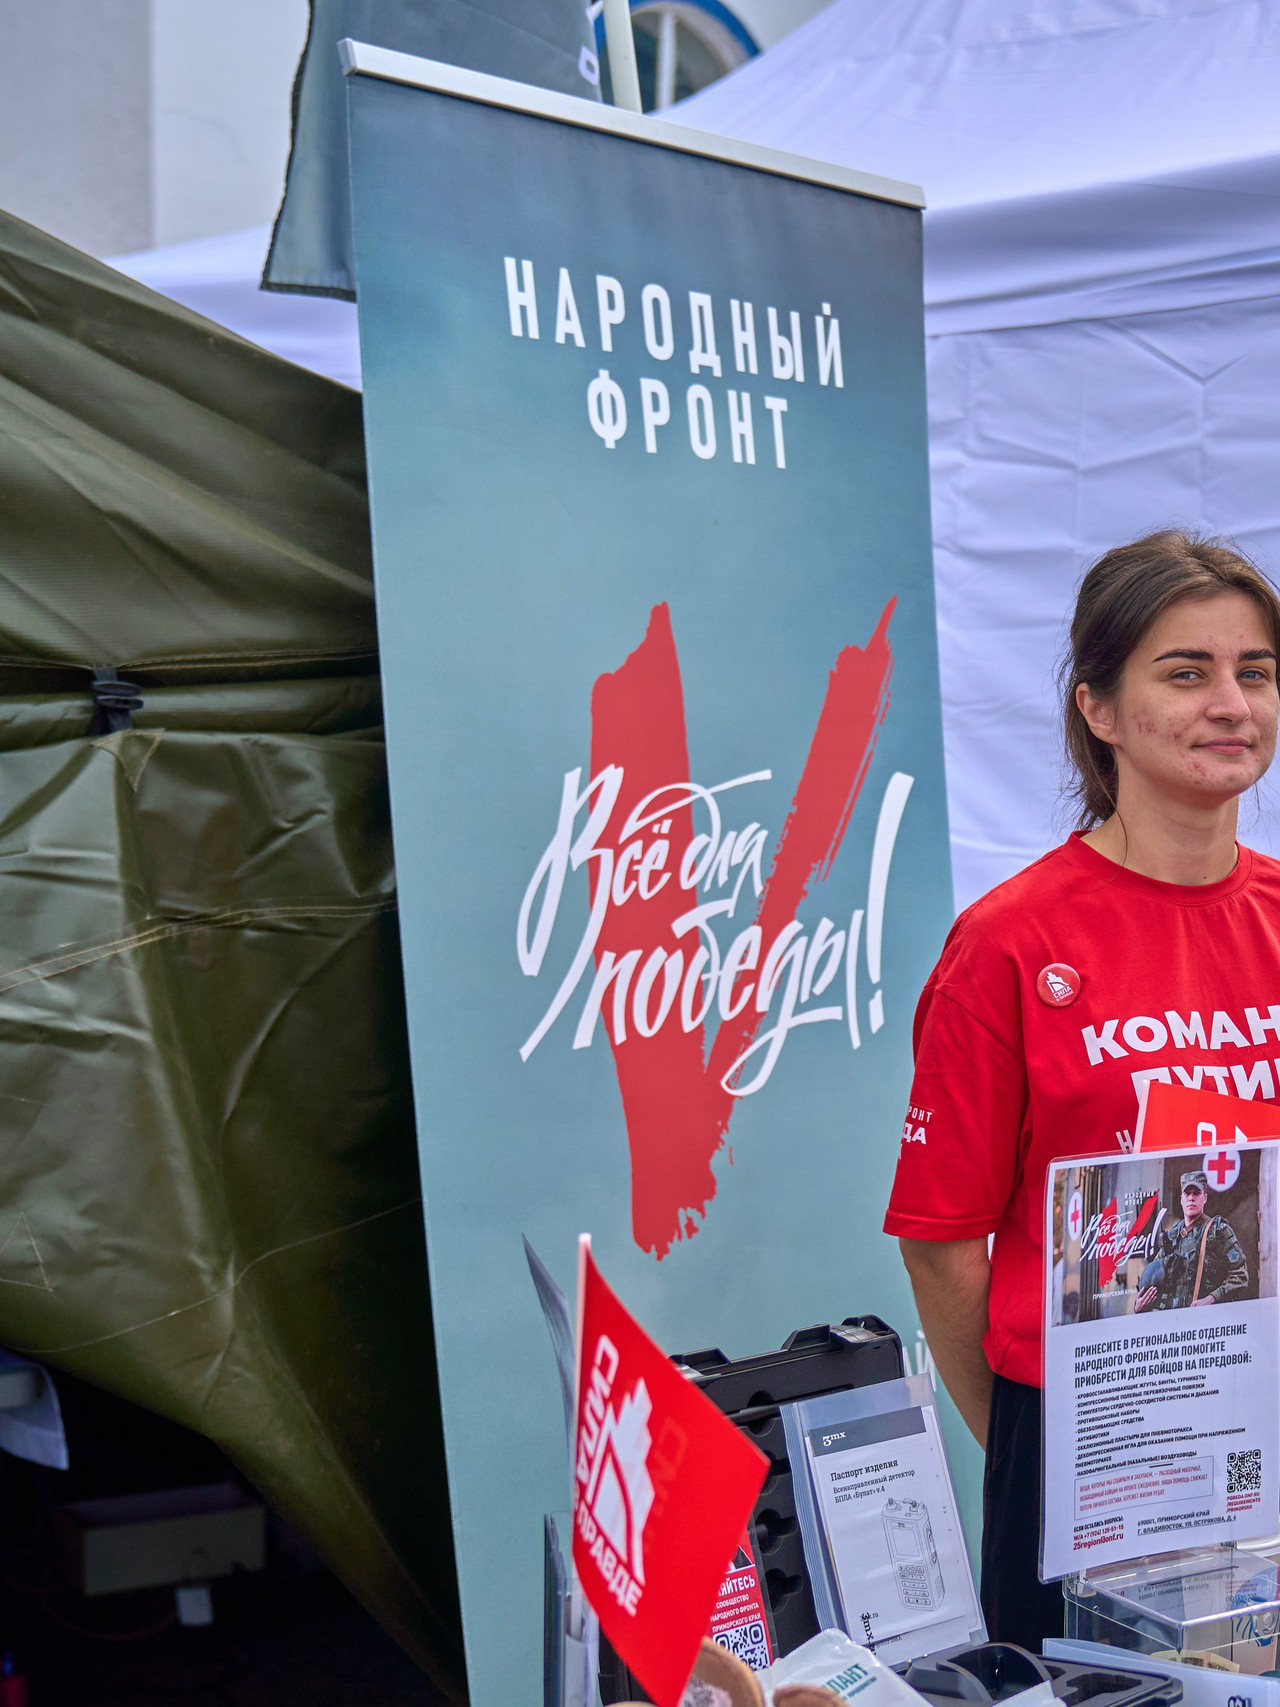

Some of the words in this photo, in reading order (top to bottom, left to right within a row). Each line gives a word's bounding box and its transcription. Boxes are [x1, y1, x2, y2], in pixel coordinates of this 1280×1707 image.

[504, 255, 844, 389] НАРОДНЫЙ
[587, 369, 788, 469] ФРОНТ
[516, 764, 672, 1062] Всё
[619, 768, 772, 897] для
[572, 771, 914, 1096] победы!
[907, 1105, 933, 1123] РОНТ
[1088, 1208, 1167, 1266] победы!
[1075, 1340, 1121, 1358] ПРИНЕСИТЕ
[1123, 1339, 1129, 1350] В
[1131, 1330, 1197, 1349] РЕГИОНАЛЬНОЕ
[1198, 1324, 1247, 1340] ОТДЕЛЕНИЕ
[1075, 1357, 1123, 1373] НАРОДНОГО
[1125, 1349, 1159, 1365] ФРОНТА
[1161, 1346, 1179, 1359] ИЛИ
[1181, 1341, 1225, 1357] ПОМОГИТЕ
[1075, 1371, 1127, 1388] ПРИОБРЕСТИ
[1128, 1366, 1147, 1380] ДЛЯ
[1148, 1361, 1183, 1376] БОЙЦОВ
[1185, 1359, 1197, 1370] НА
[1199, 1351, 1252, 1369] ПЕРЕДОВОЙ:
[830, 1467, 863, 1482] Паспорт
[864, 1459, 899, 1475] изделия
[833, 1475, 887, 1494] Всенаправленный
[888, 1470, 916, 1483] детектор
[835, 1493, 852, 1503] БПЛА
[1157, 1511, 1194, 1523] ПРИМОРСКИЙ
[1195, 1510, 1210, 1518] КРАЙ
[576, 1501, 643, 1617] ПРАВДЕ
[718, 1574, 756, 1597] ЯЙТЕСЬ
[710, 1607, 740, 1622] НАРОДНОГО
[739, 1602, 760, 1614] ФРОНТА
[716, 1593, 749, 1609] СООБЩЕСТВО
[712, 1616, 748, 1633] ПРИМОРСКОГО
[748, 1613, 761, 1623] КРАЯ
